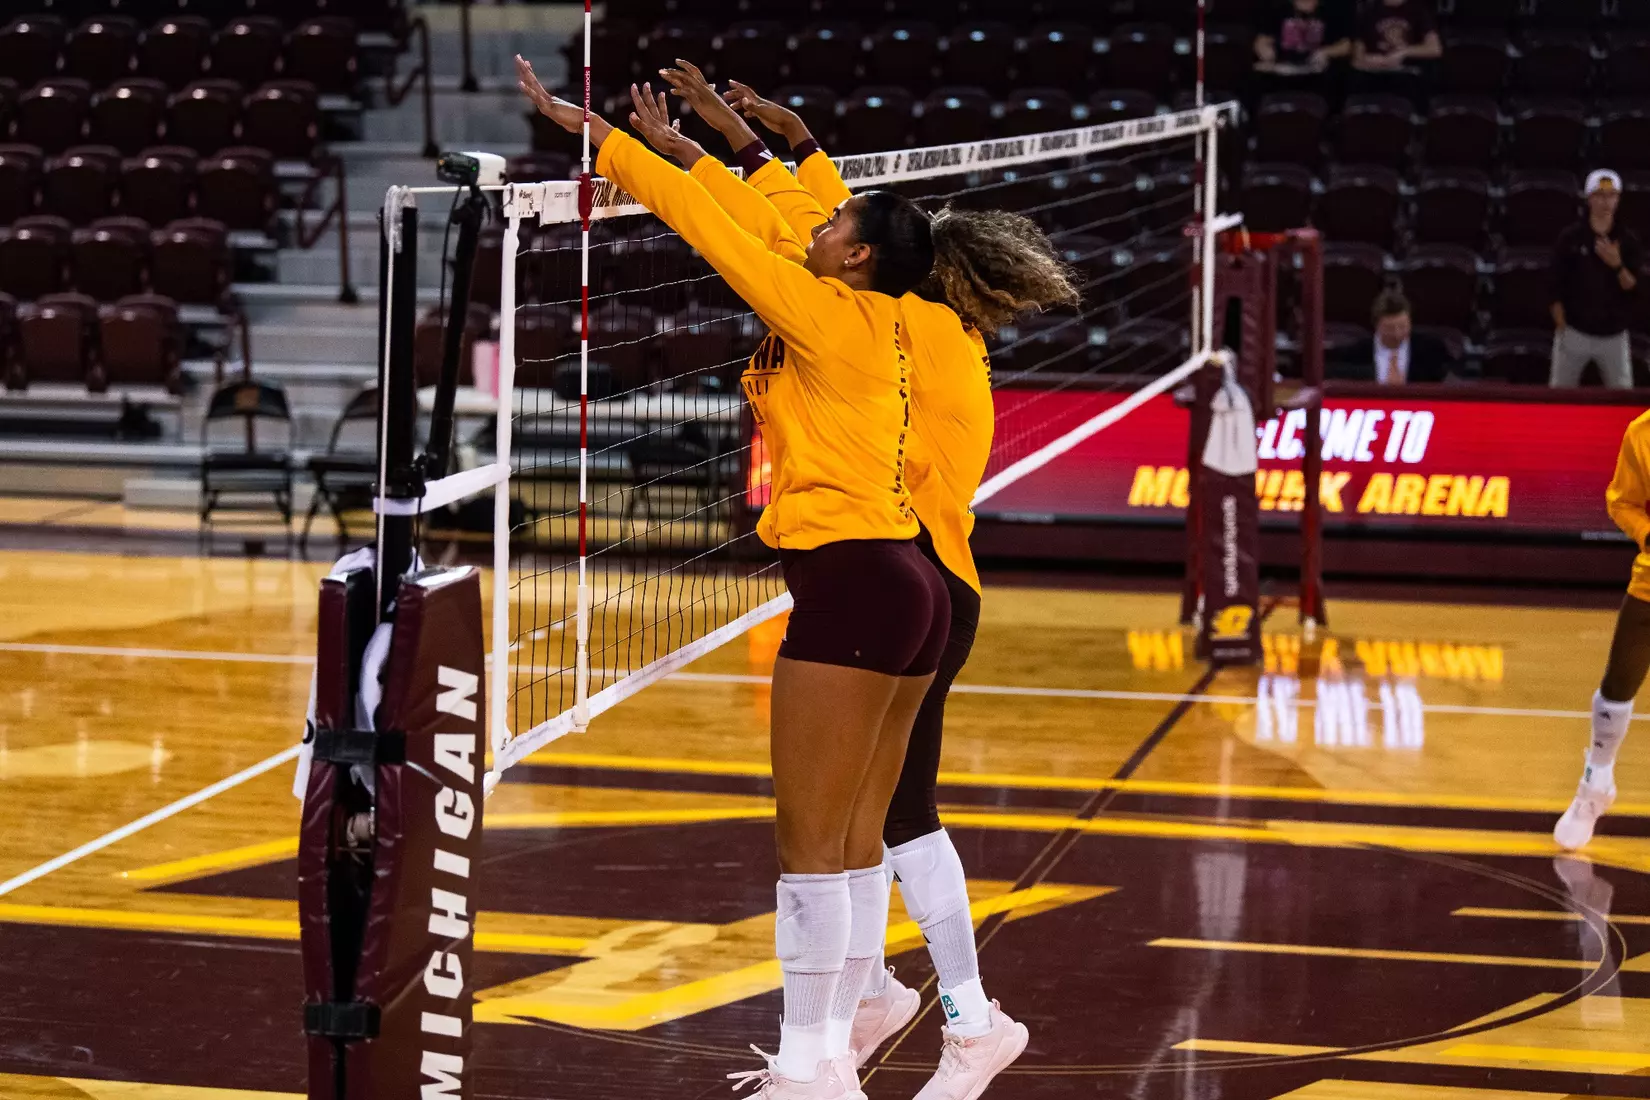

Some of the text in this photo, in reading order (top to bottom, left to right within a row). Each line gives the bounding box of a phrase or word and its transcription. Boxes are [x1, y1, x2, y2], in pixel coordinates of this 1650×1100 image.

[1255, 408, 1435, 463] LCME TO
[1357, 472, 1511, 518] ARENA
[419, 665, 479, 1100] MICHIGAN
